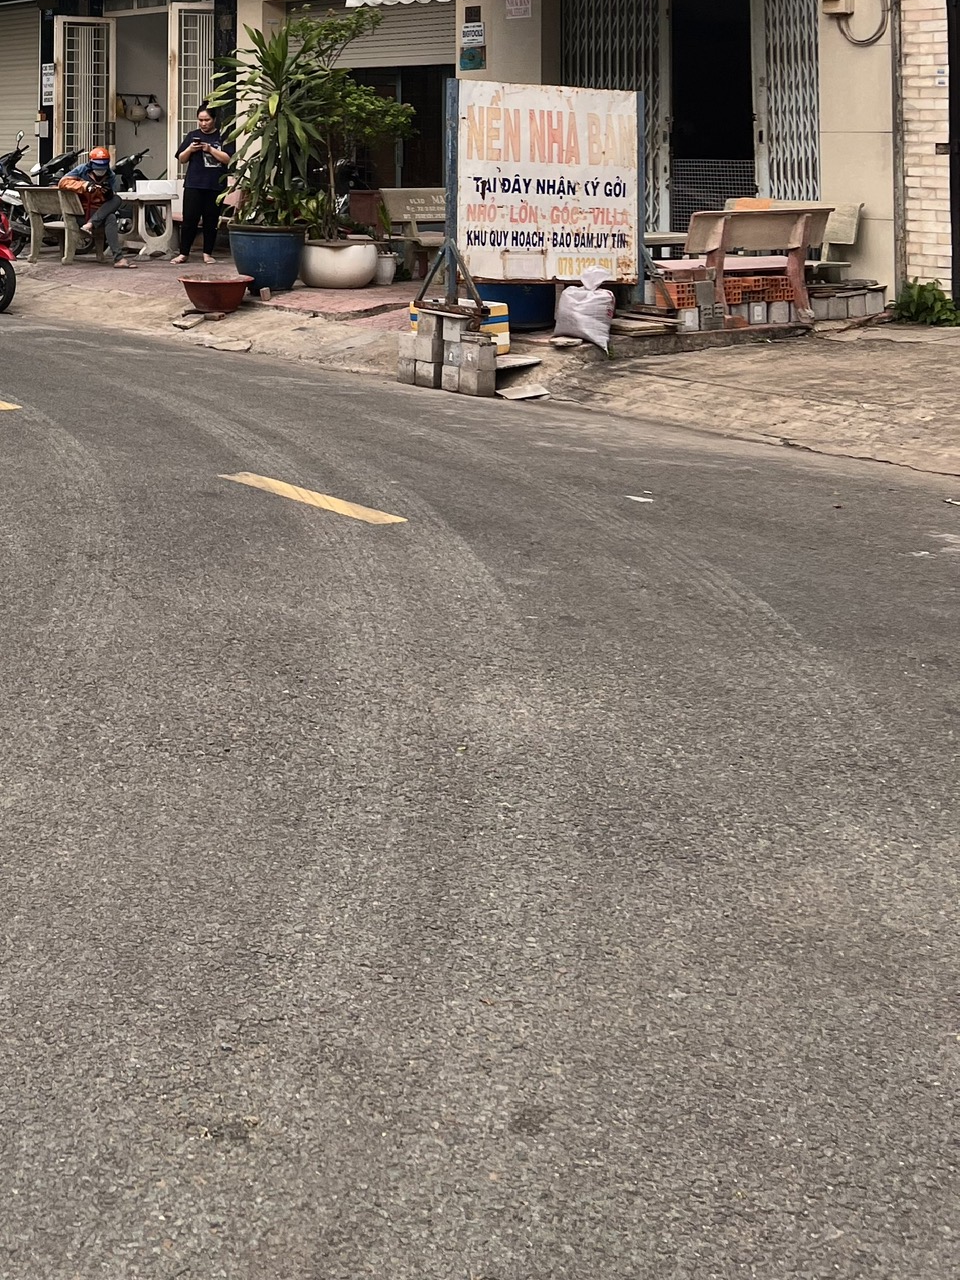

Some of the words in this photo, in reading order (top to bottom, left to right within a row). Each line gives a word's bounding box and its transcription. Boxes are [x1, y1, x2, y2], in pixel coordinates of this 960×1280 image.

[467, 90, 521, 163] NỀN
[529, 97, 581, 165] NHÀ
[536, 176, 576, 200] NHẬN
[593, 207, 630, 226] VILLA
[466, 230, 487, 247] KHU
[490, 230, 509, 247] QUY
[512, 230, 545, 251] HOẠCH
[552, 226, 572, 248] BẢO
[597, 233, 609, 249] UY
